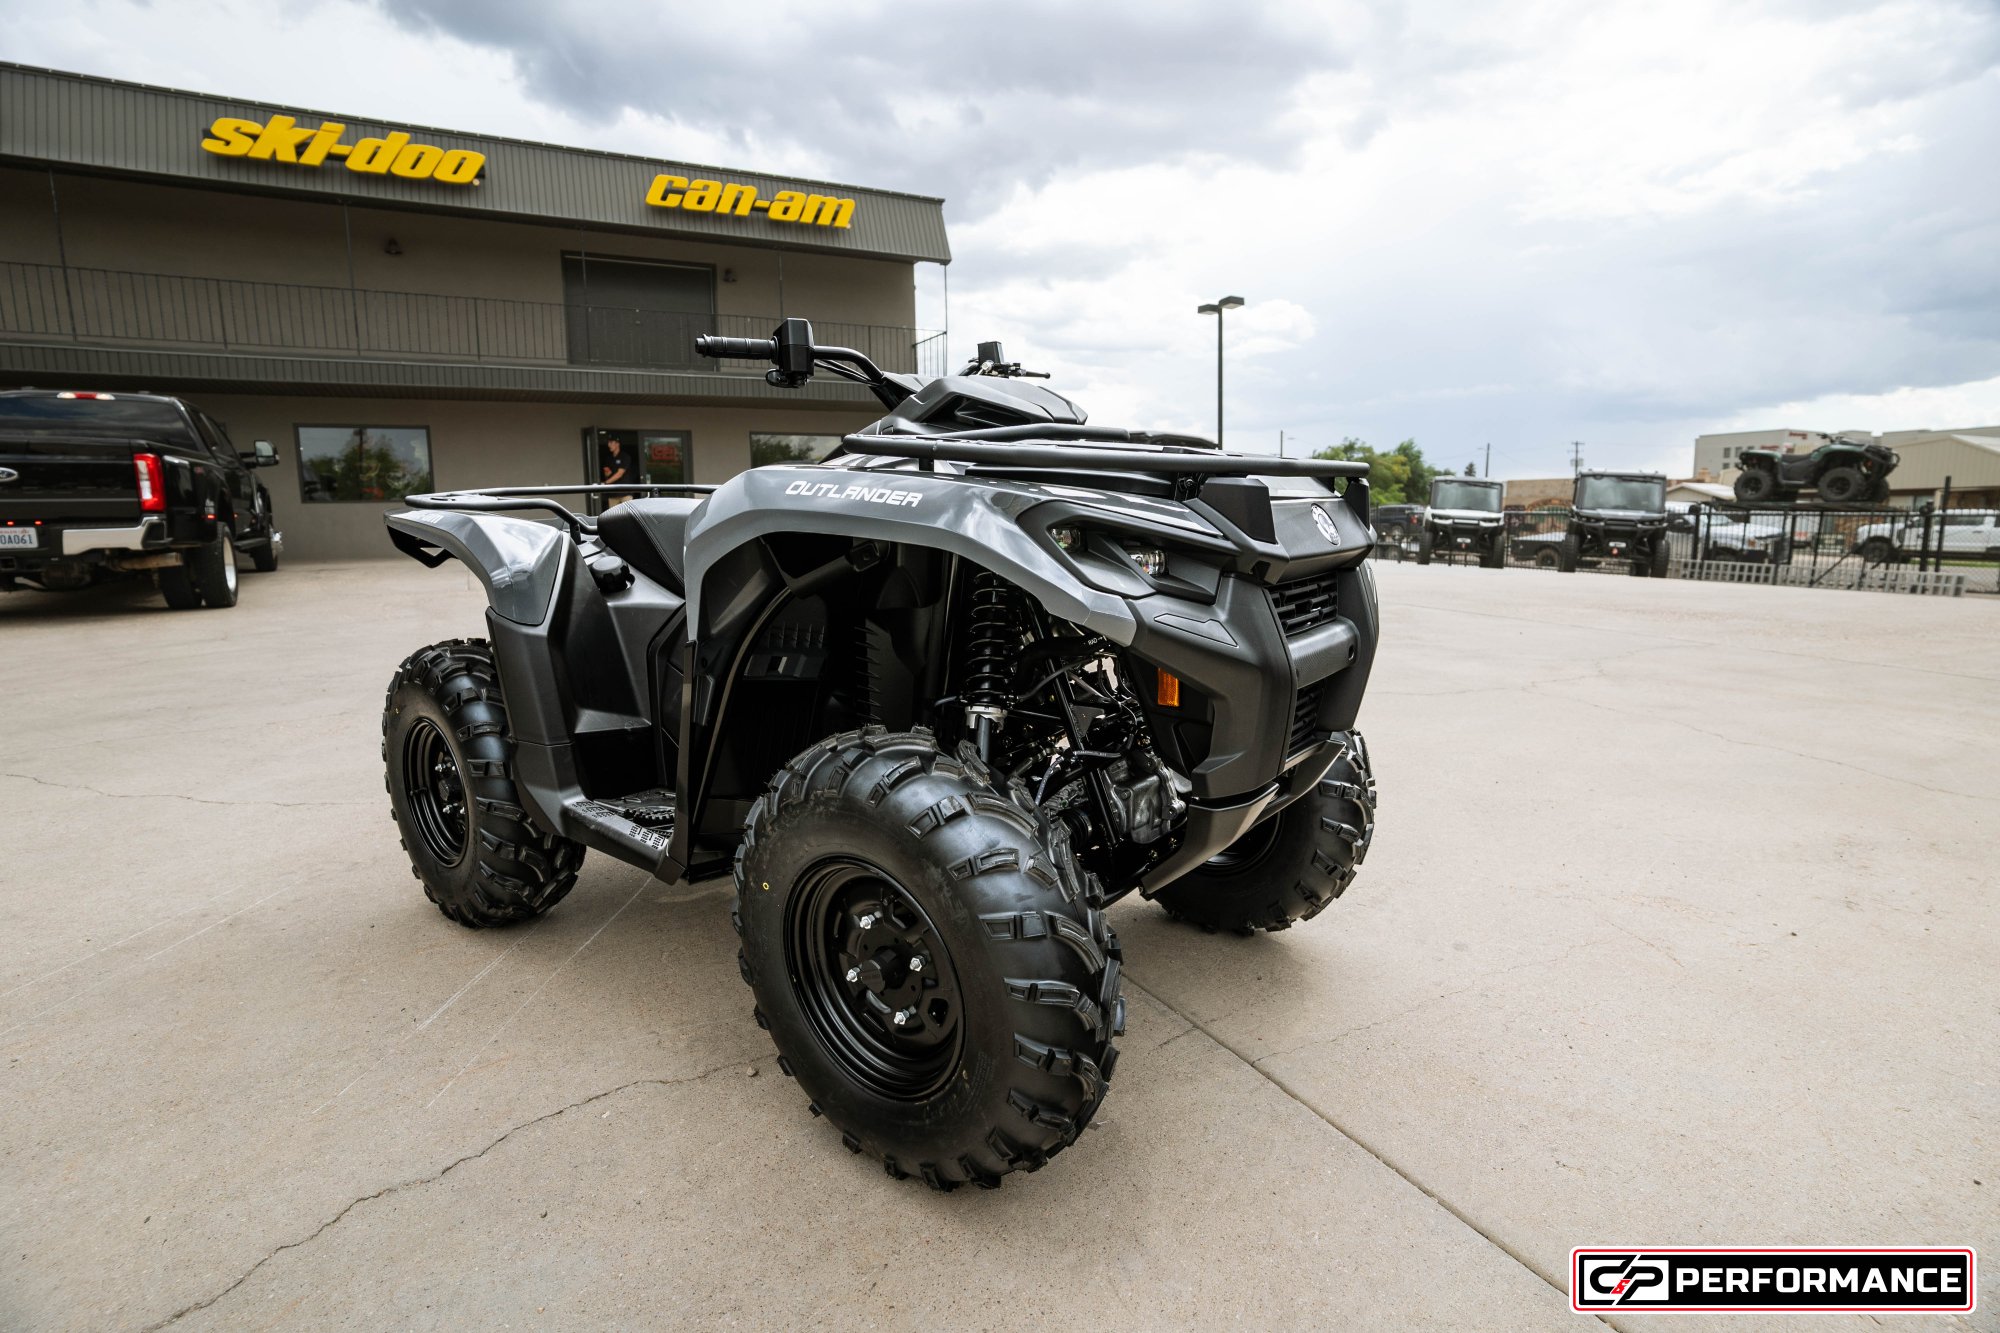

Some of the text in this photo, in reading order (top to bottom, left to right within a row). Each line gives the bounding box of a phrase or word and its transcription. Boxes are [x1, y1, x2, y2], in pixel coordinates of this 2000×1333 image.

[201, 115, 486, 184] ski-doo
[646, 174, 855, 229] can-am
[785, 480, 924, 508] OUTLANDER
